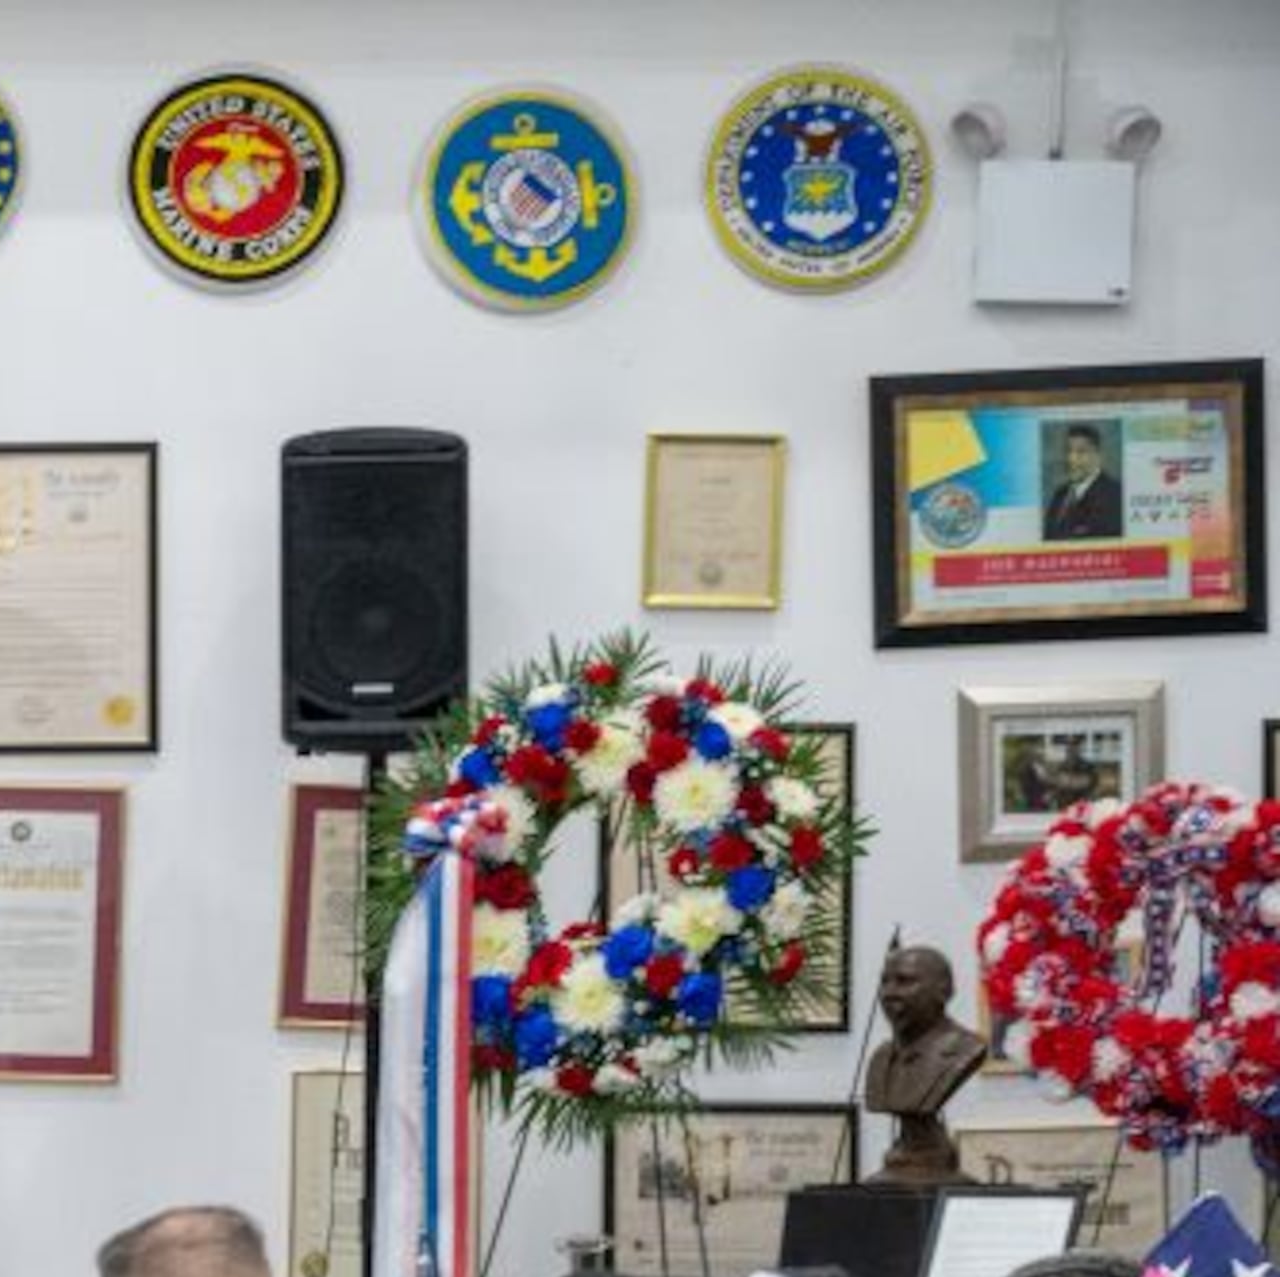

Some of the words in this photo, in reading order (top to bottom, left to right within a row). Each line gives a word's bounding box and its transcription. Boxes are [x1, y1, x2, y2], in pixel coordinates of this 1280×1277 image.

[157, 96, 245, 149] UNITED
[252, 100, 321, 169] STATES
[153, 187, 233, 260] MARINE
[244, 206, 313, 260] CORPS
